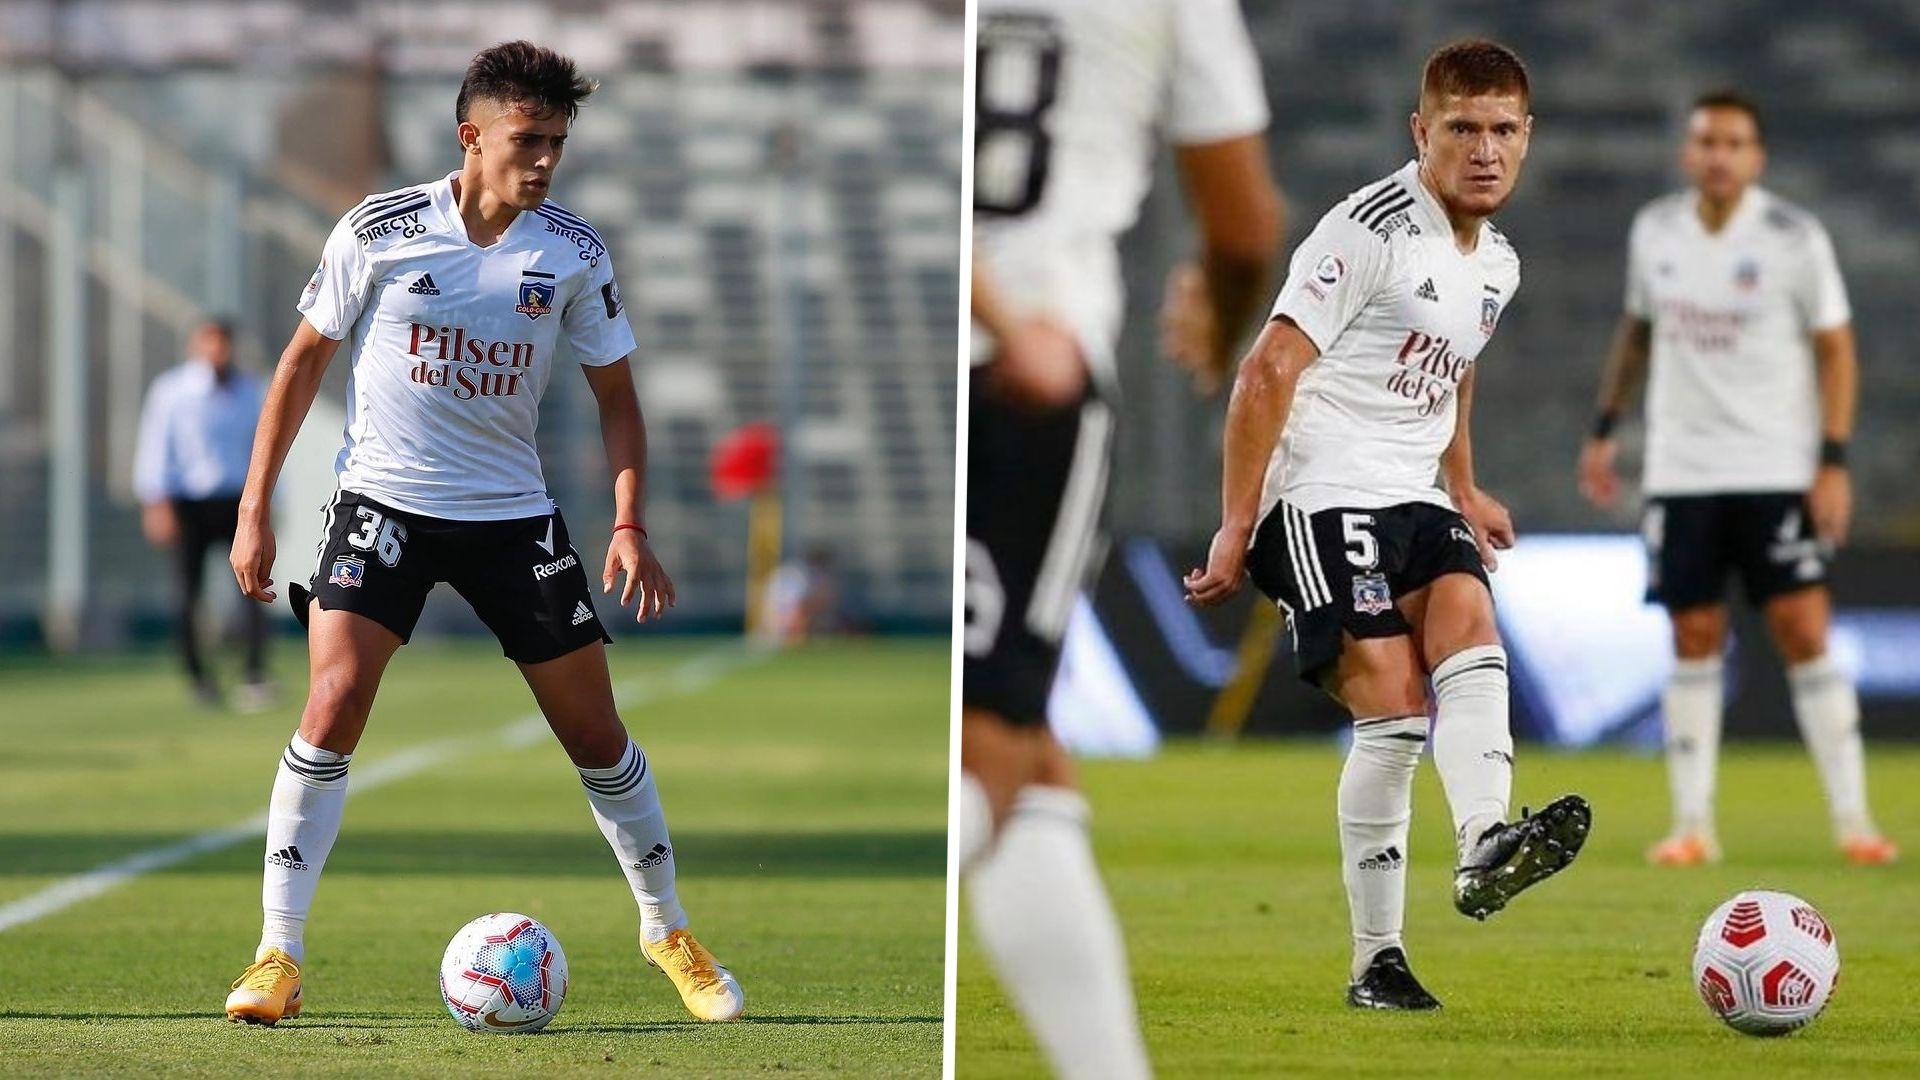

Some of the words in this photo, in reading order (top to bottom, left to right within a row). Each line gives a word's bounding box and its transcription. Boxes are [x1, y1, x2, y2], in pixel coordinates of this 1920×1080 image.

[357, 212, 418, 246] DIRECTV
[403, 224, 426, 238] GO
[545, 220, 604, 258] DIRECTV
[579, 251, 598, 268] GO
[408, 286, 441, 296] adidas
[517, 306, 551, 314] COLO-COLO
[408, 322, 535, 368] Pilsen
[1394, 329, 1472, 383] Pilse
[411, 361, 450, 387] del
[453, 366, 524, 400] Sur
[1387, 369, 1424, 399] del
[347, 505, 408, 568] 36
[1342, 513, 1379, 569] 5
[532, 554, 577, 581] Rexona
[572, 611, 593, 625] adidas
[268, 856, 309, 871] adidas
[633, 846, 671, 869] adidas
